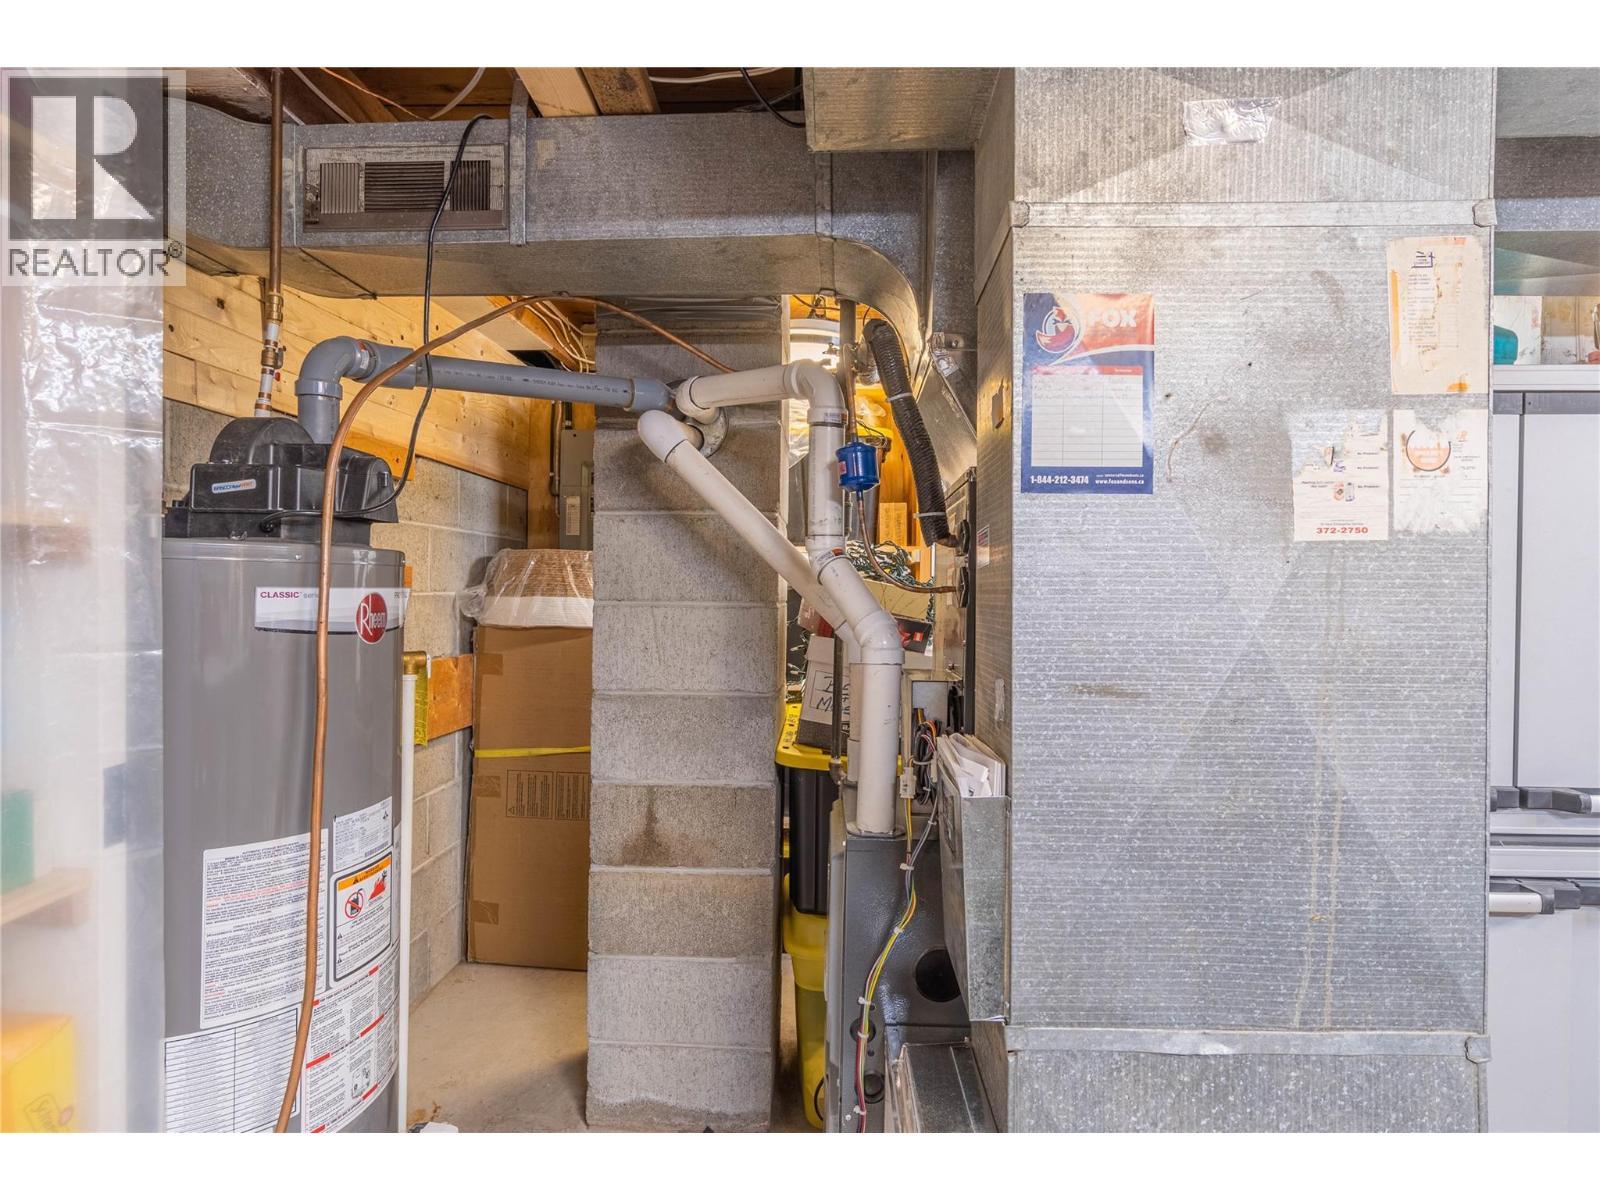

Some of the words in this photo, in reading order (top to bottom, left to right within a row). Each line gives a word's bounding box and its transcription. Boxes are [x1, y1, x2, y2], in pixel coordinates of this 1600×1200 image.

[1088, 308, 1137, 328] FOX
[1030, 475, 1089, 484] 1-844-212-3474
[1316, 526, 1369, 535] 372-2750
[260, 591, 300, 599] CLASSIC
[360, 593, 386, 636] Rheem
